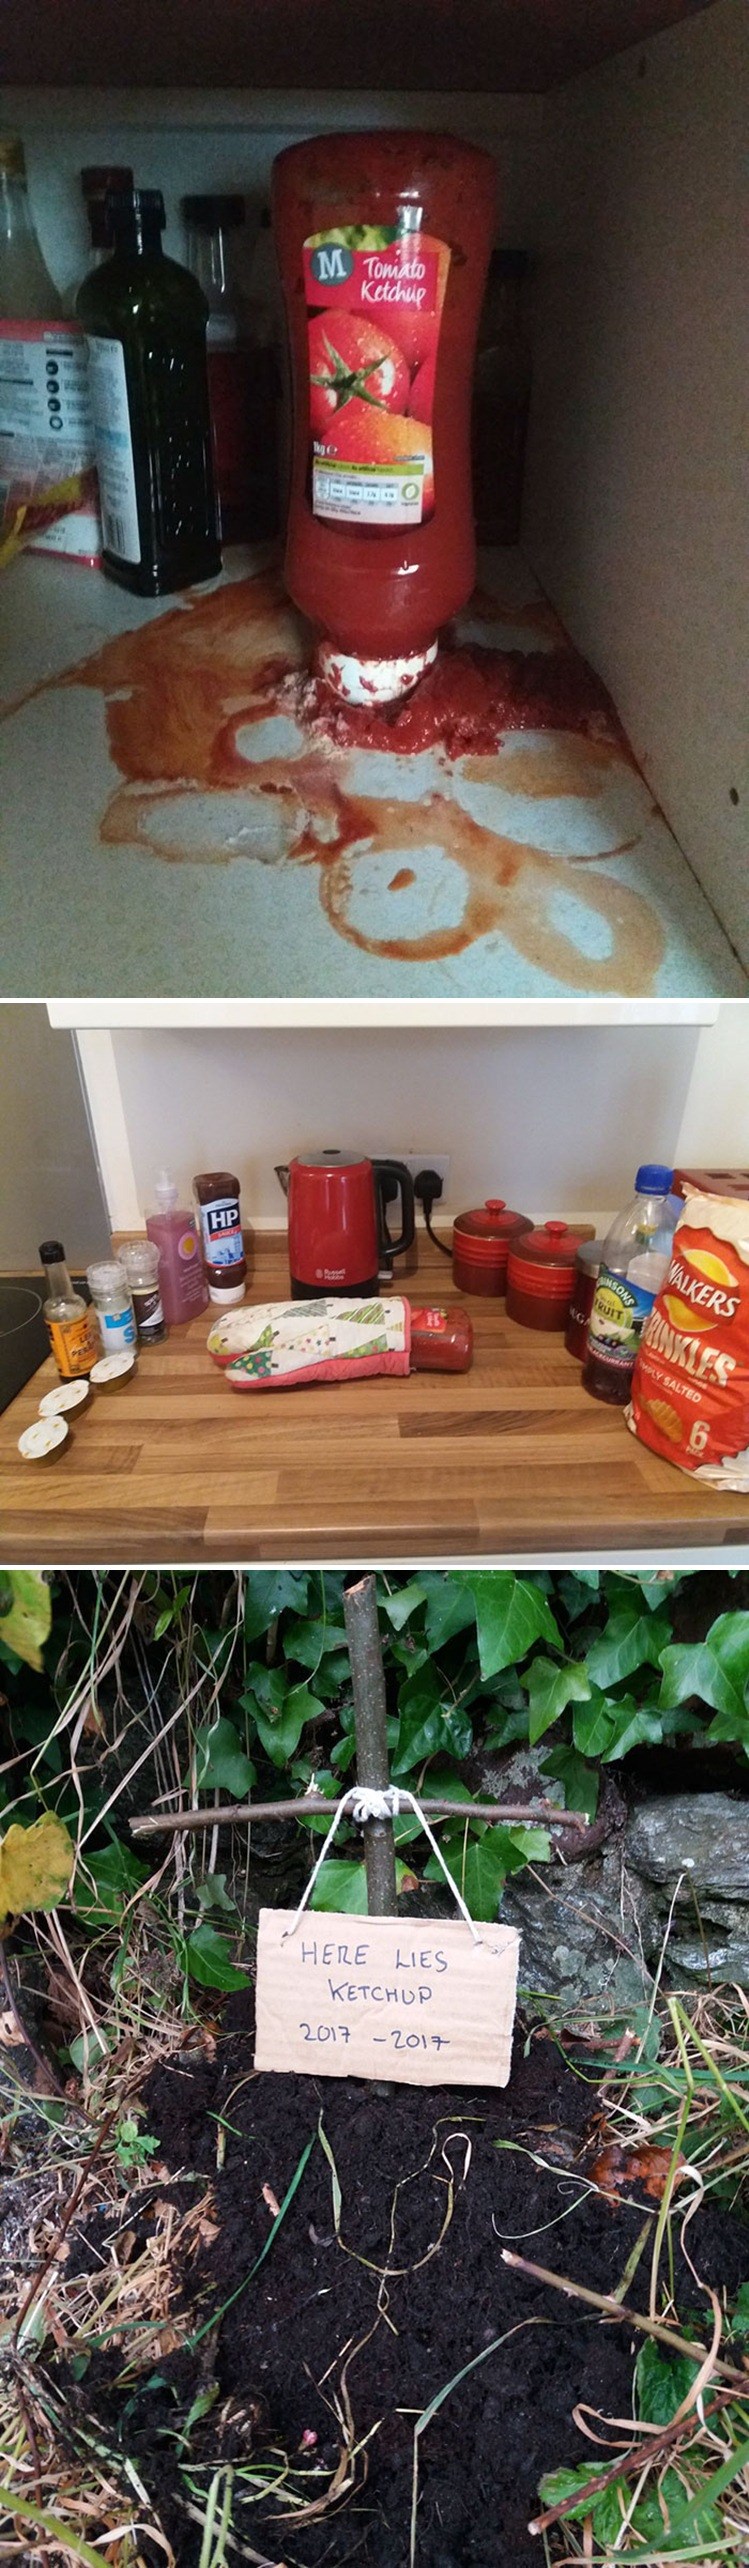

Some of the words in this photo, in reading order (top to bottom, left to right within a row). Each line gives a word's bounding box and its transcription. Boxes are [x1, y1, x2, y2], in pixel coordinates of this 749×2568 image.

[316, 248, 347, 280] M
[362, 256, 426, 280] Tomato
[361, 280, 427, 310] Ketchup
[210, 1208, 239, 1230] HP
[668, 1259, 742, 1318] WALKERS
[662, 1376, 703, 1403] SALTED
[690, 1419, 711, 1451] 6
[301, 1941, 370, 1965] HERE
[395, 1949, 448, 1973] LIES
[327, 1979, 432, 2005] KETCHUP
[299, 2023, 351, 2043] 2017
